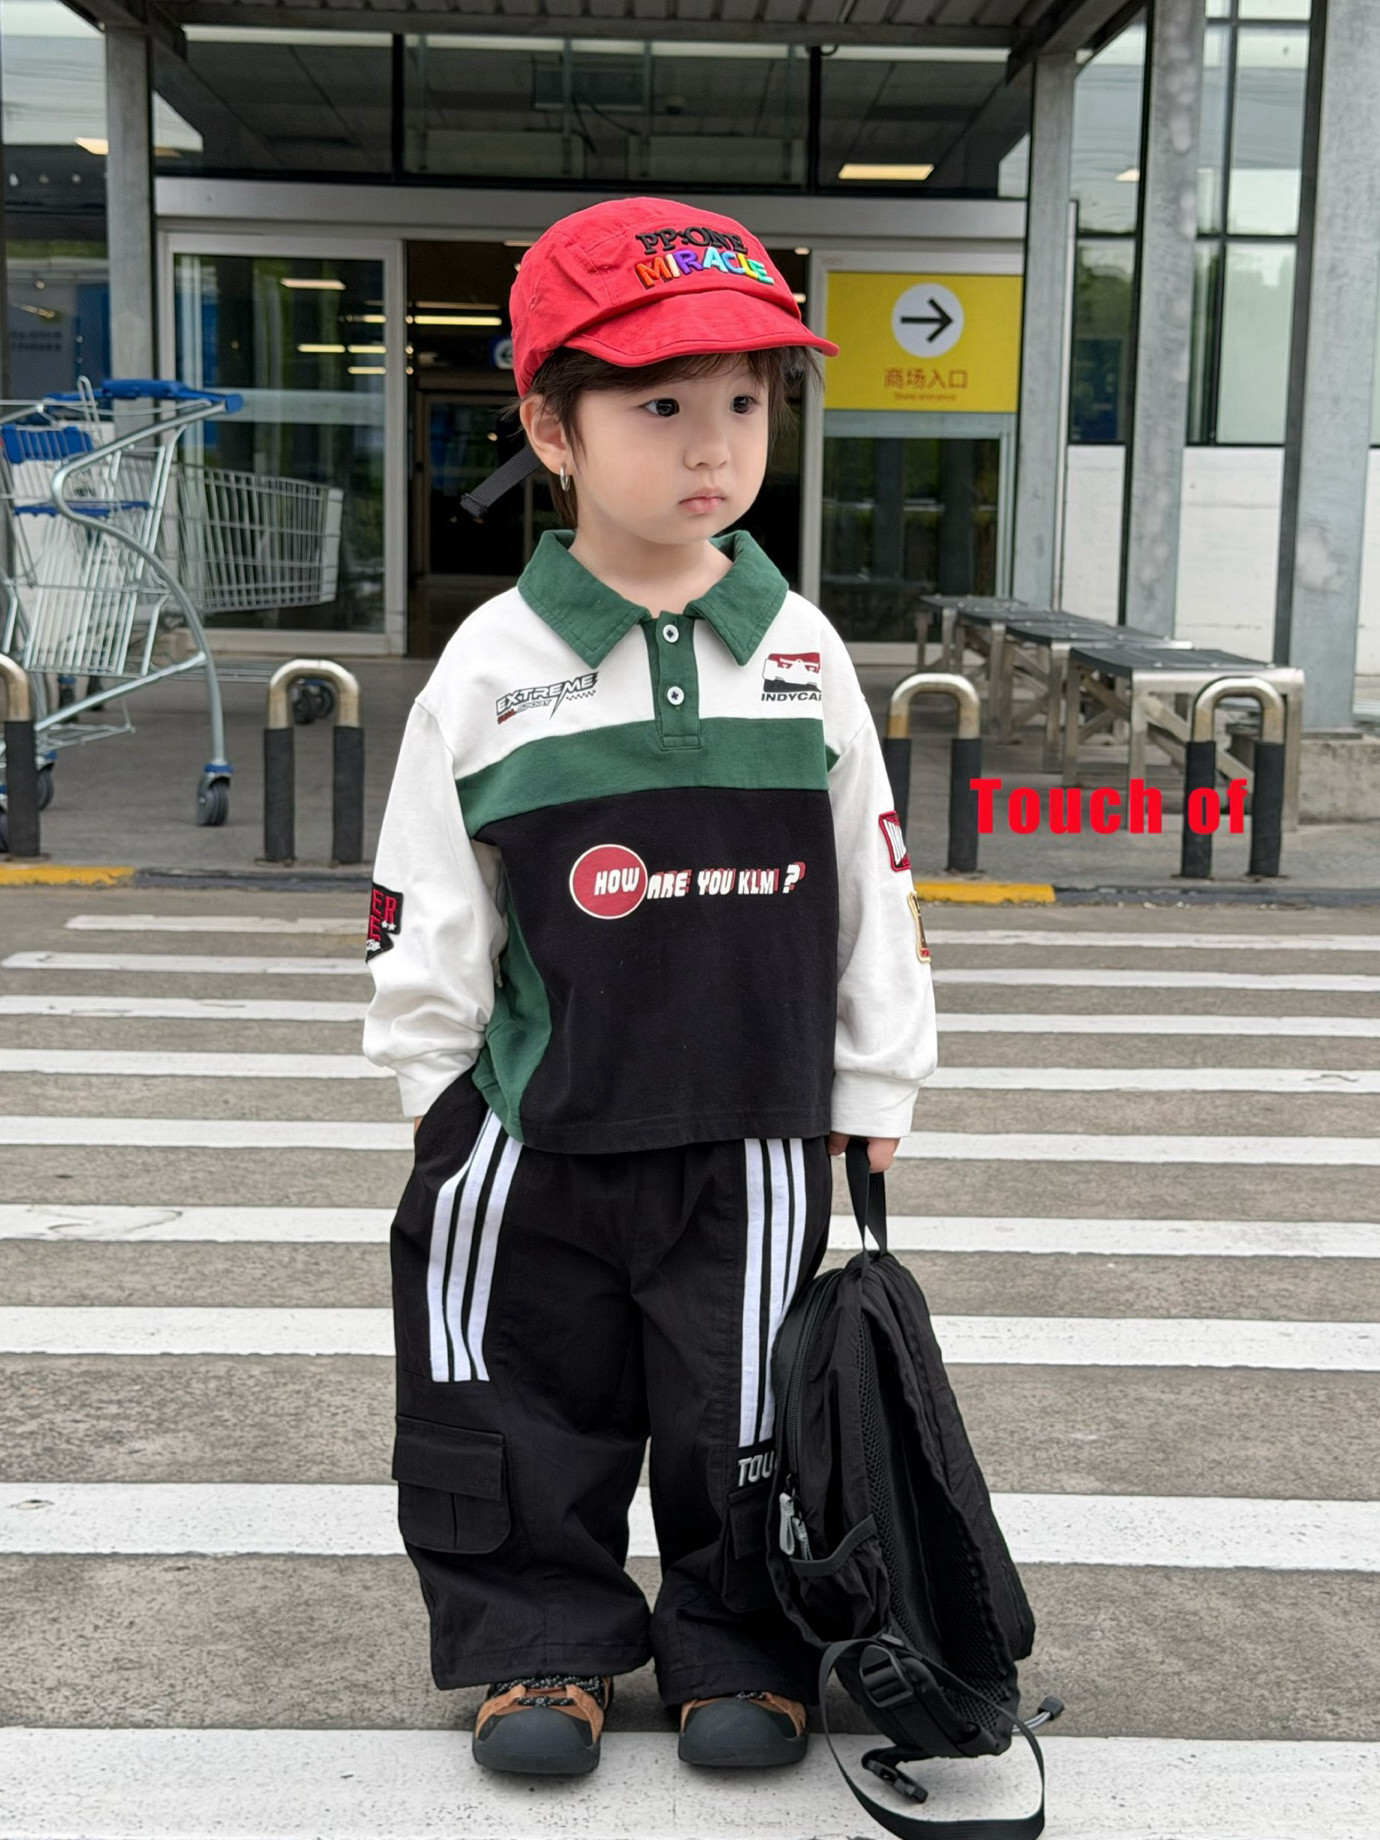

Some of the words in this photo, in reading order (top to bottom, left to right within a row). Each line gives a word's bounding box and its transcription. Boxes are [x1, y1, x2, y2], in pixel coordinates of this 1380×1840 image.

[635, 246, 775, 290] MIRACLE
[884, 368, 968, 389] 商场入口
[496, 672, 599, 719] EXTREME
[594, 867, 640, 896] HOW
[646, 869, 693, 900] ARE
[697, 868, 736, 895] YOU
[737, 868, 780, 895] KLM
[738, 1450, 777, 1487] TOU
